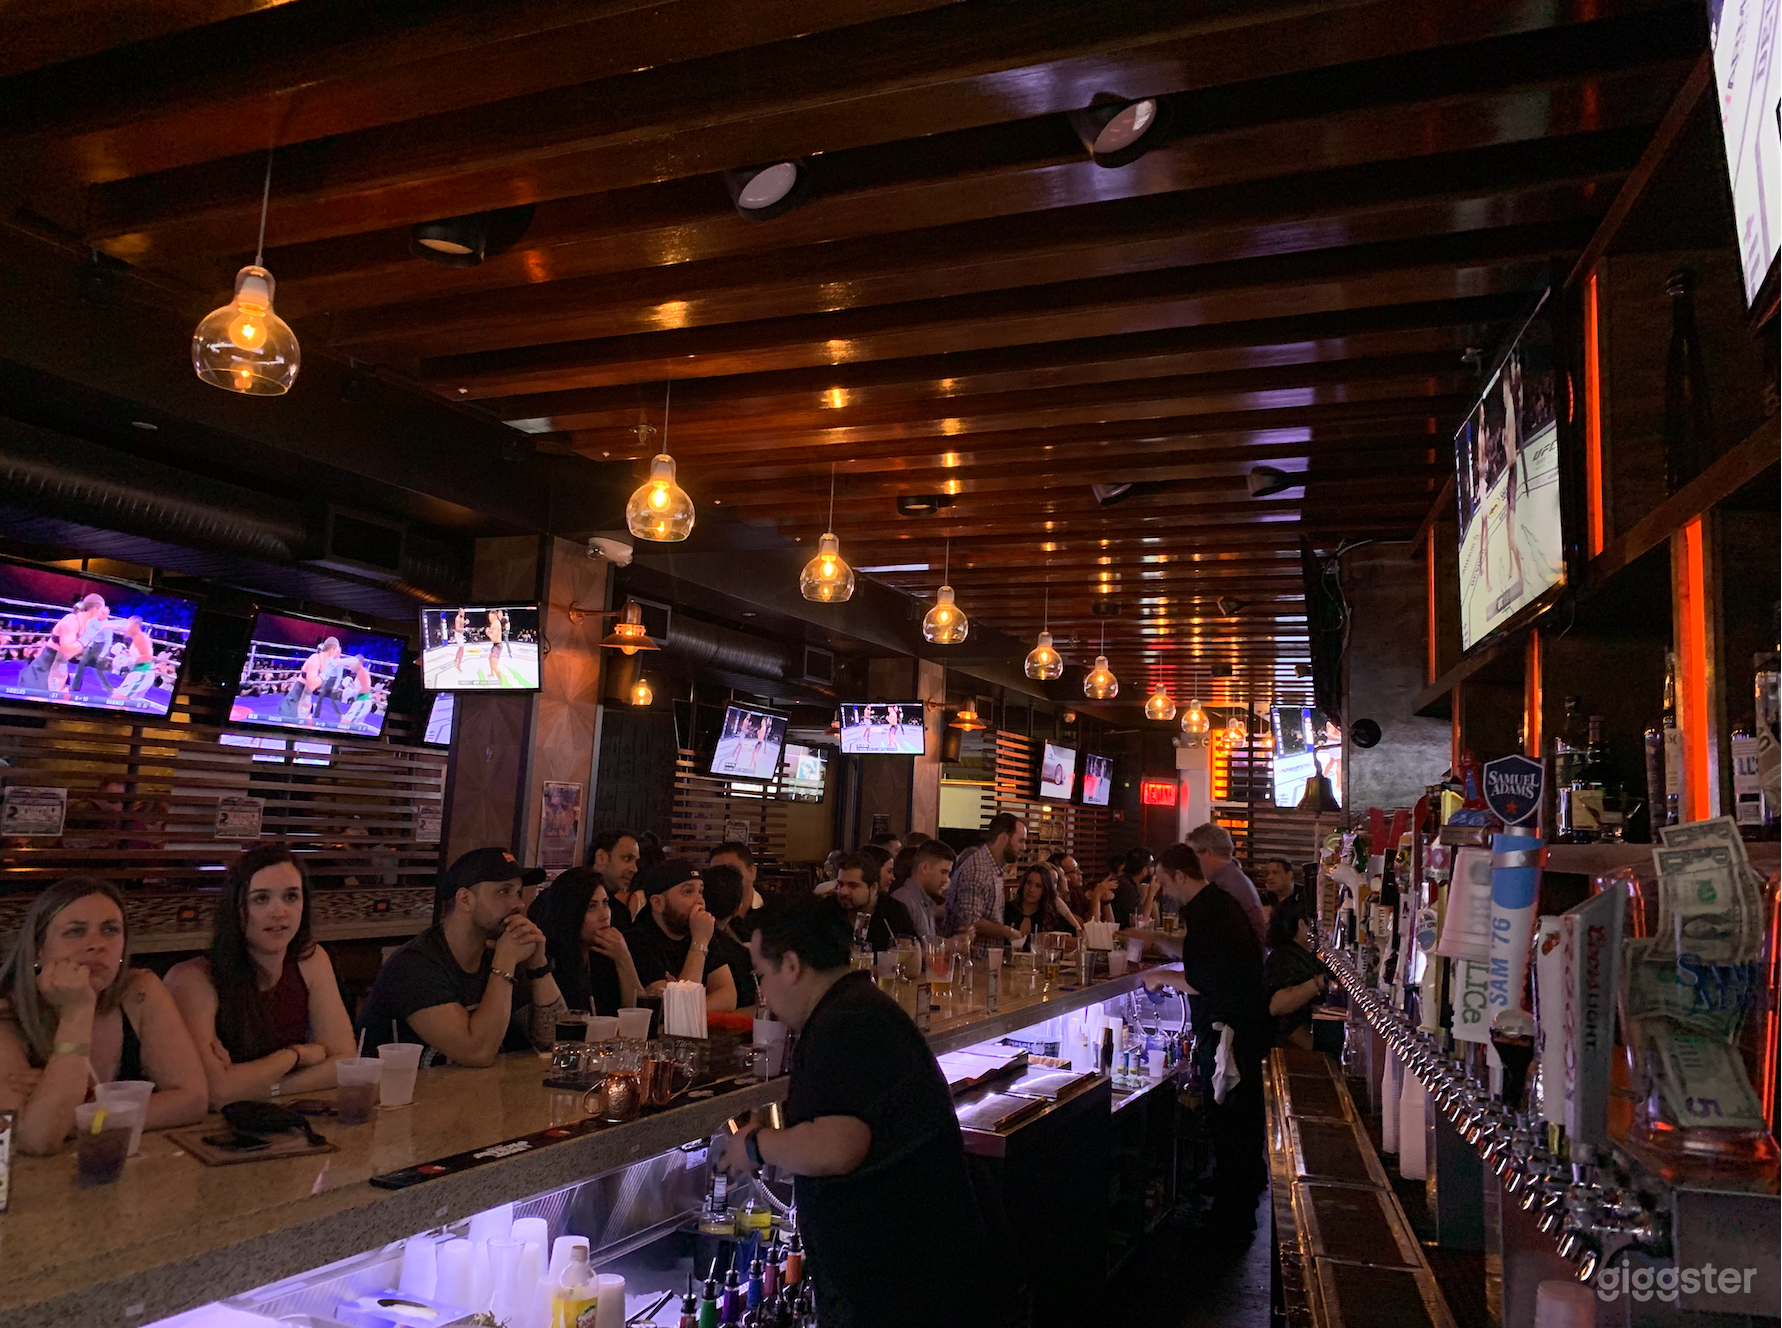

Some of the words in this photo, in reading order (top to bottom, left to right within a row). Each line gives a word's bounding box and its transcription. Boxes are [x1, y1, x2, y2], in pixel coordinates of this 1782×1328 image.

[1488, 770, 1540, 788] SAMUEL
[1490, 783, 1535, 800] ADAMS
[1489, 957, 1510, 1008] SAM
